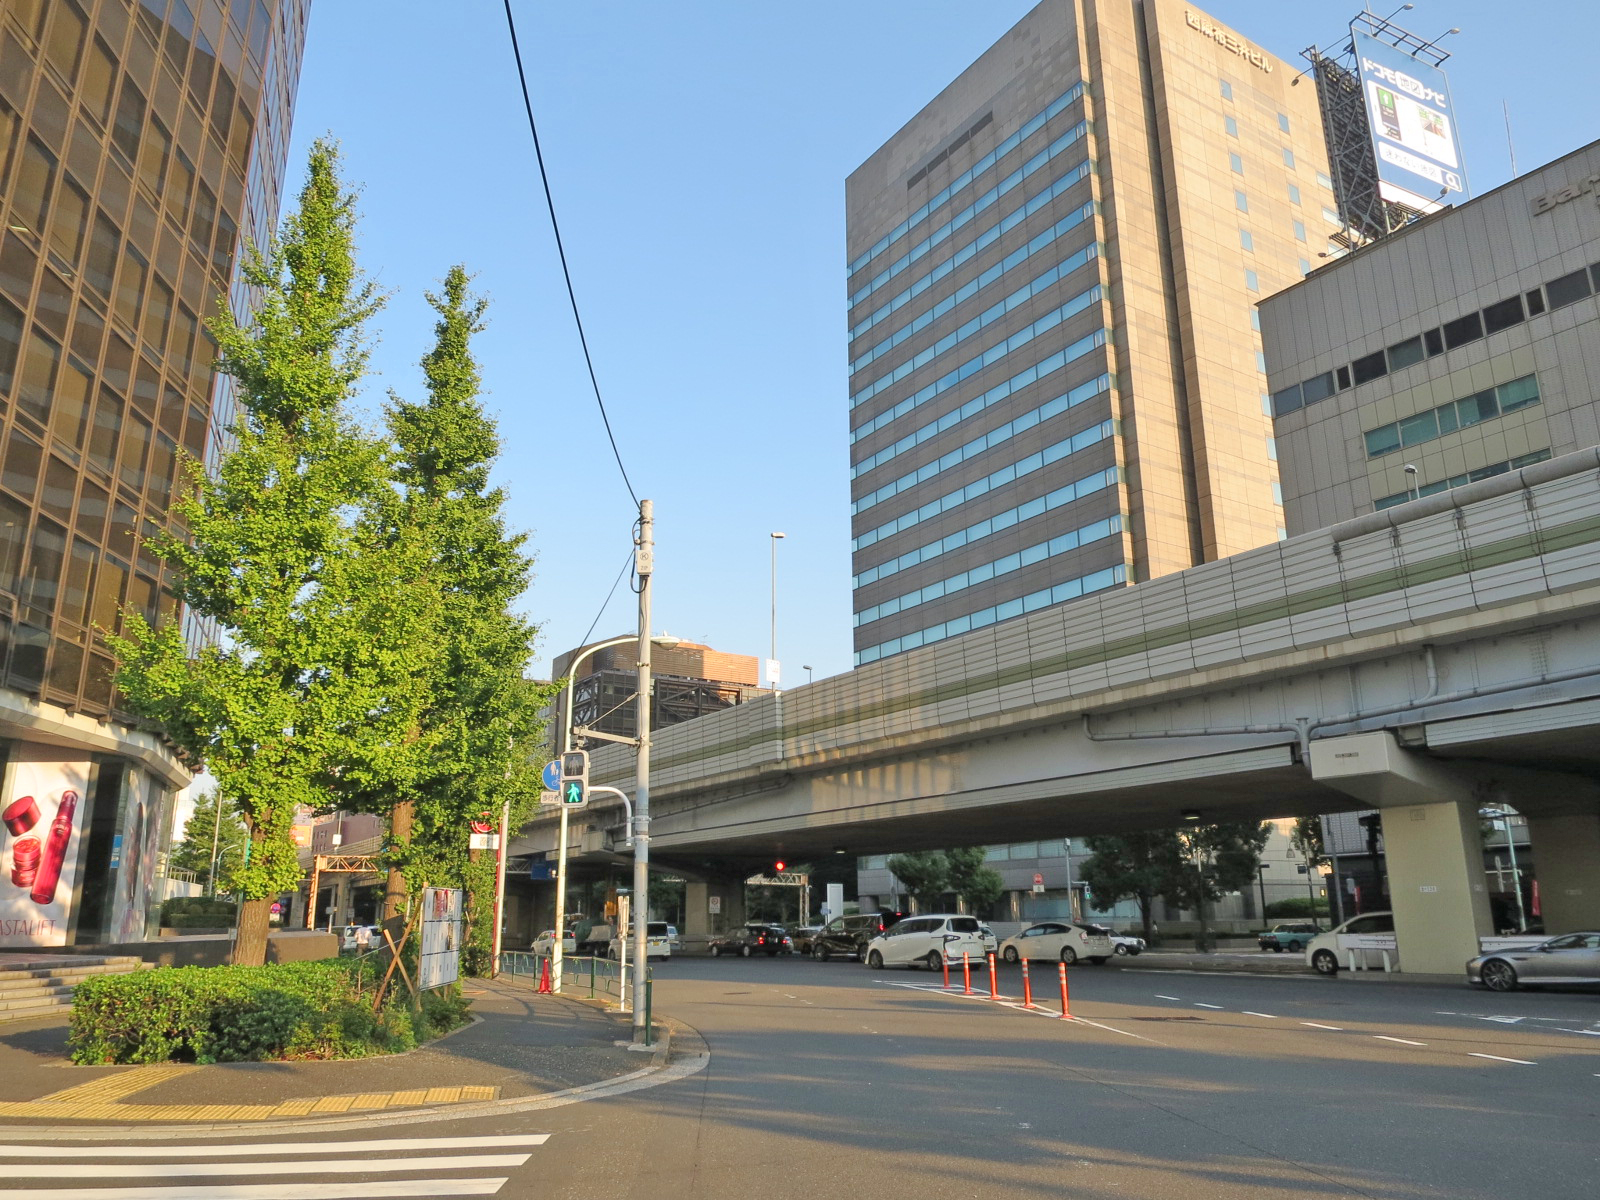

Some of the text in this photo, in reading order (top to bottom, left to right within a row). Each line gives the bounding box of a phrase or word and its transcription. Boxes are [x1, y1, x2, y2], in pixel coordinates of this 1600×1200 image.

[1362, 57, 1446, 109] ドコモ地図ナビ
